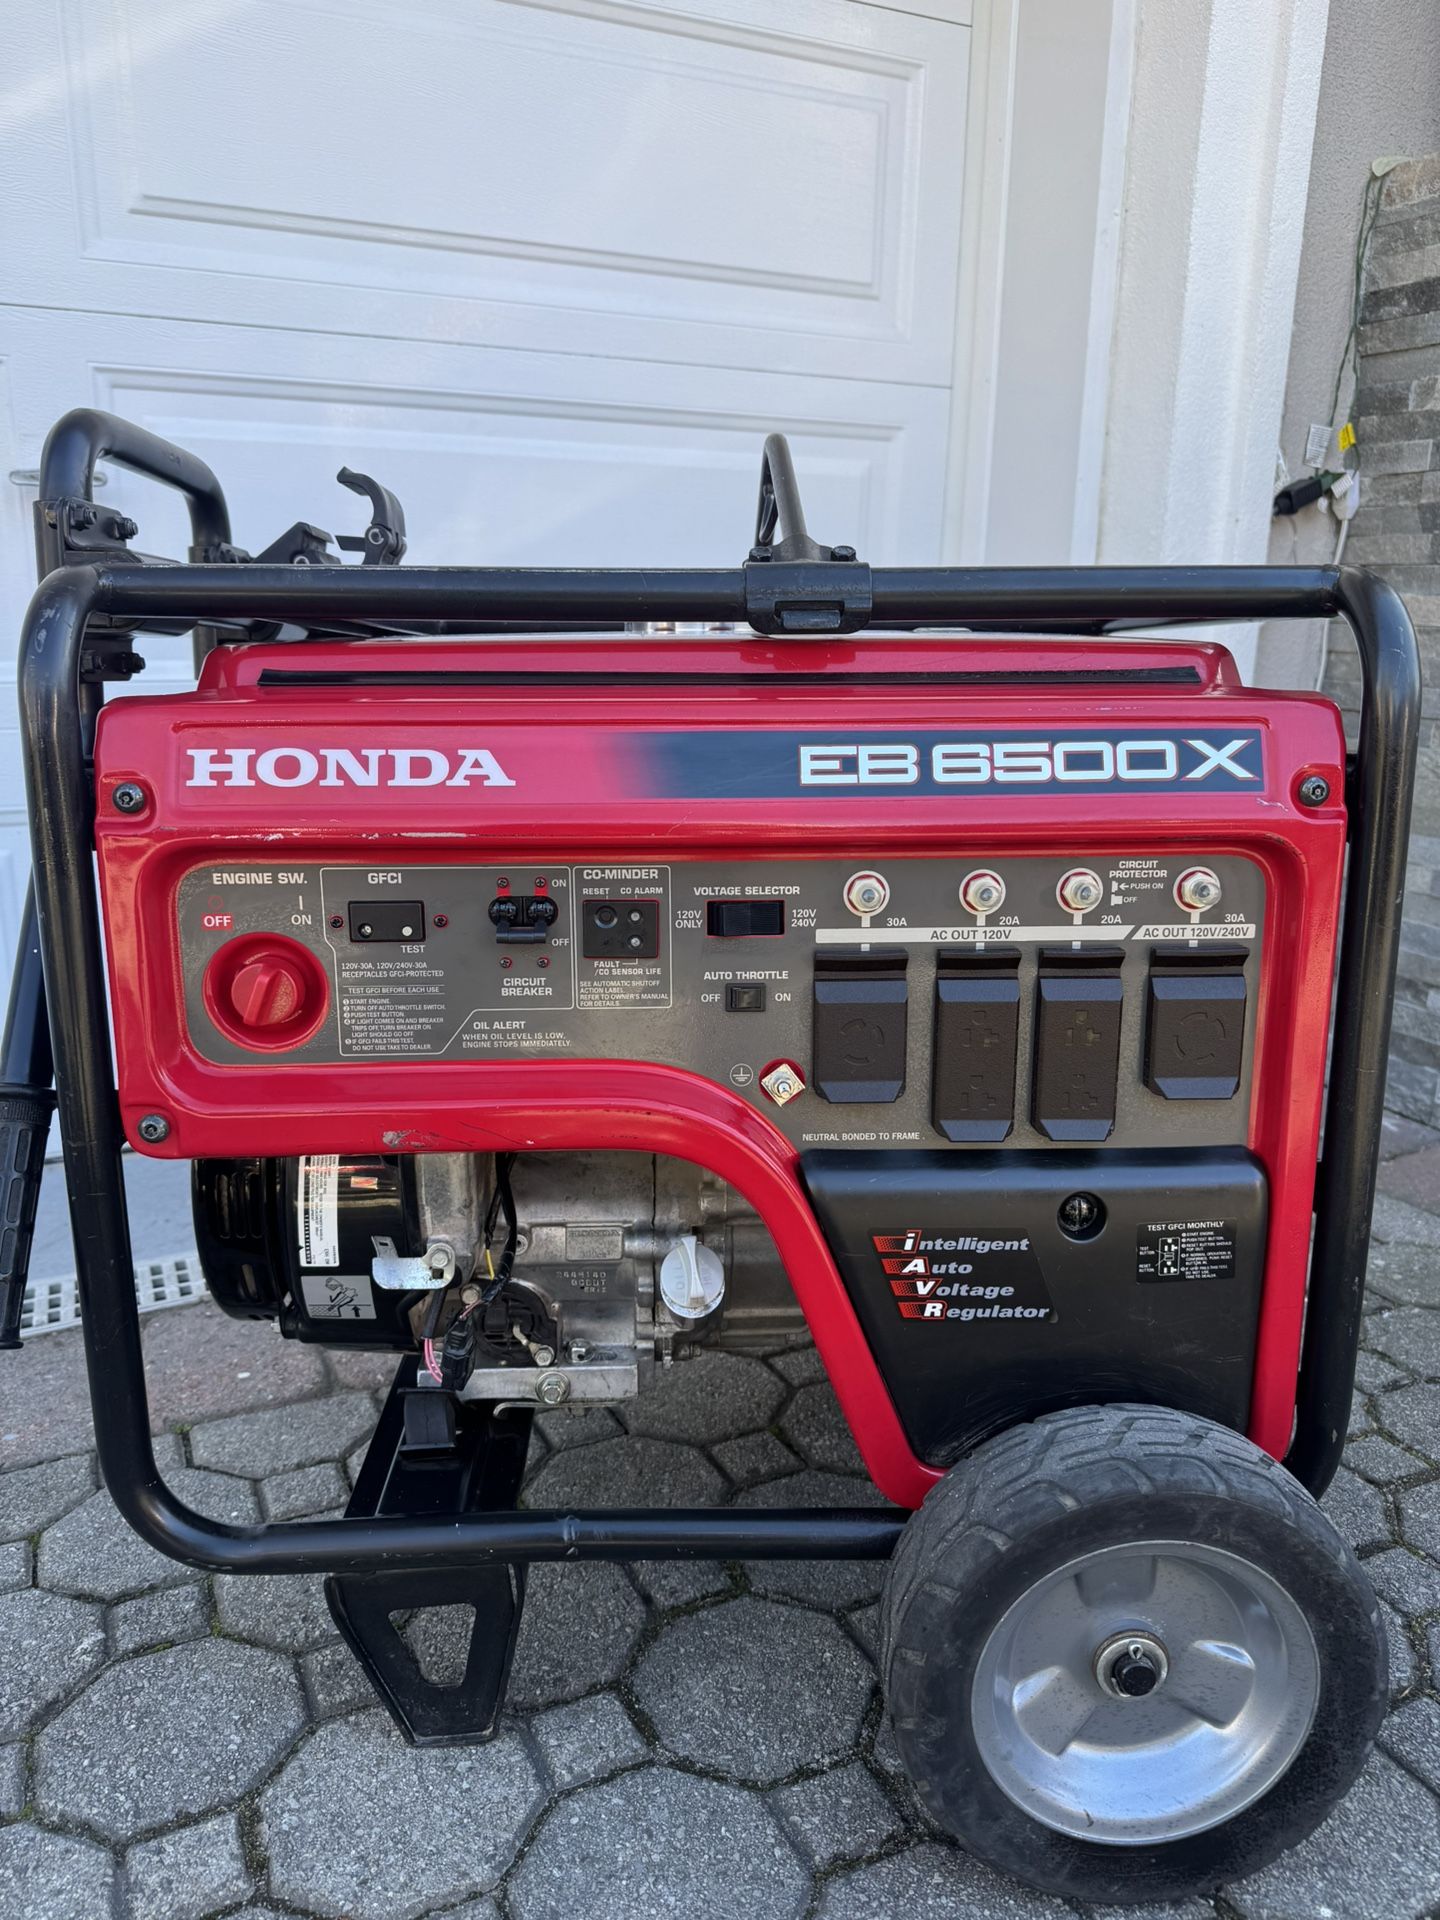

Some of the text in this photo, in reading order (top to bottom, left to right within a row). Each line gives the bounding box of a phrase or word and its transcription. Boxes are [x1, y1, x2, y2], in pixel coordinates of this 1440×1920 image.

[186, 748, 516, 787] HONDA
[1119, 860, 1158, 869] CIRCUIT
[212, 872, 308, 885] ENGINE SW.
[368, 873, 402, 884] GFCI
[583, 869, 658, 880] CO-MINDER
[1110, 870, 1168, 878] PROTECTOR
[694, 886, 800, 895] VOLTAGE SELECTOR
[677, 910, 702, 919] 120V
[792, 909, 816, 918] 120V
[1225, 914, 1245, 922] 30A
[204, 916, 231, 927] OFF
[291, 915, 312, 925] ON
[675, 920, 703, 928] ONLY
[791, 919, 817, 927] 240V
[886, 917, 907, 926] 30A
[999, 917, 1020, 925] 20A
[1101, 915, 1122, 924] 20A
[930, 929, 1012, 940] AC OUT 120V
[1143, 926, 1249, 938] AC OUT 120V/240V
[400, 945, 426, 953] TEST
[704, 971, 789, 979] AUTO THROTTLE
[504, 978, 546, 986] CIRCUIT
[501, 988, 552, 996] BREAKER
[701, 994, 721, 1002] OFF
[775, 993, 791, 1002] ON
[473, 1021, 526, 1030] OIL ALERT
[802, 1133, 839, 1141] NEUTRAL
[841, 1133, 877, 1141] BONDED
[879, 1133, 890, 1141] TO
[902, 1258, 973, 1275] Auto
[916, 1281, 1015, 1299] Voltage
[924, 1302, 1049, 1321] Regulator
